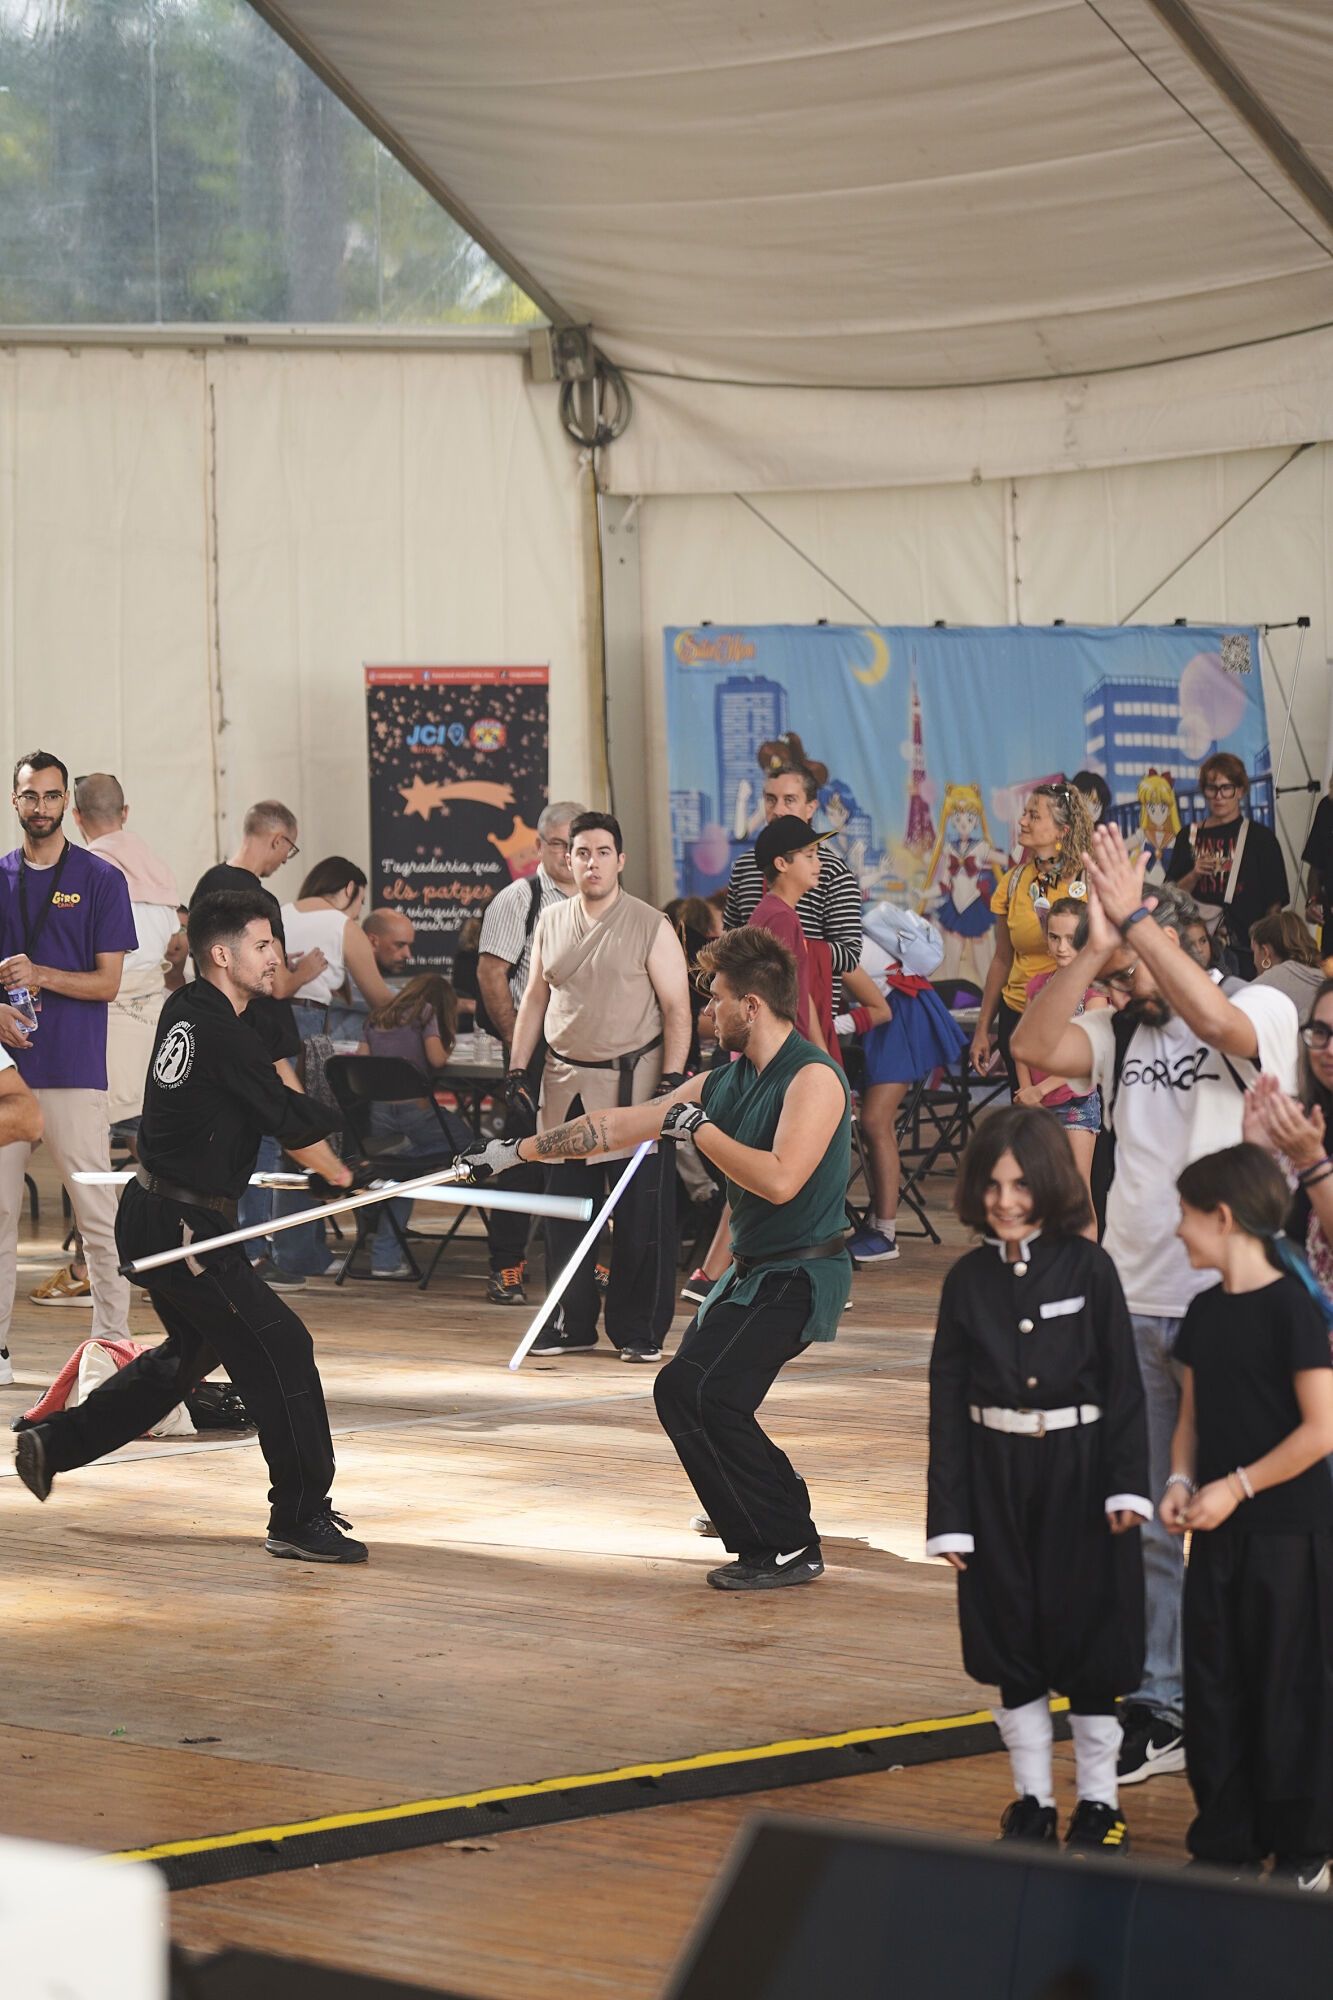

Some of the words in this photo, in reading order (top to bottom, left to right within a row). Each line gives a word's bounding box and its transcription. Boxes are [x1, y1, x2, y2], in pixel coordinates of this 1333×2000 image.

[406, 724, 446, 746] JCI
[472, 862, 501, 876] que
[382, 878, 419, 901] els
[422, 880, 494, 905] patges
[182, 1058, 194, 1081] COMBAT
